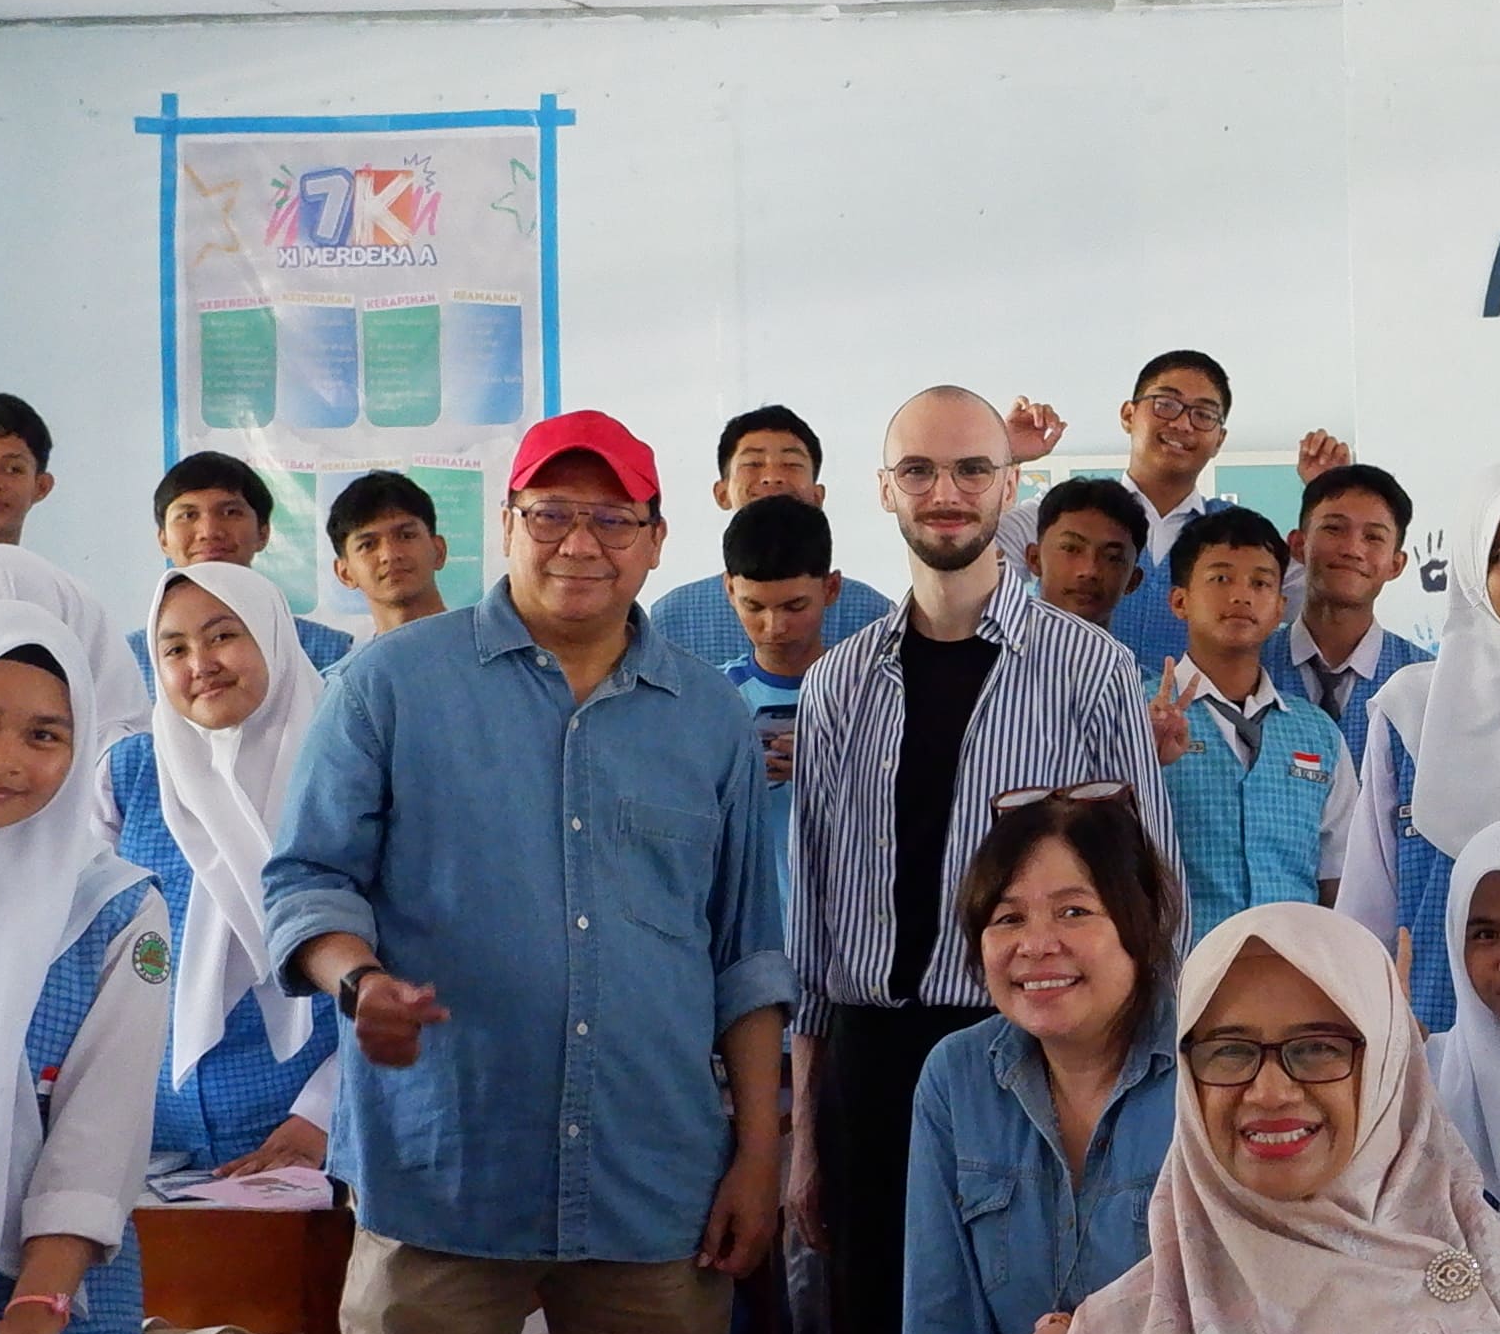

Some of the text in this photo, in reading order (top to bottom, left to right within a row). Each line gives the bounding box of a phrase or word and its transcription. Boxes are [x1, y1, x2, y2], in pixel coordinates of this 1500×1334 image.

[277, 244, 438, 268] XI MERDEKA A
